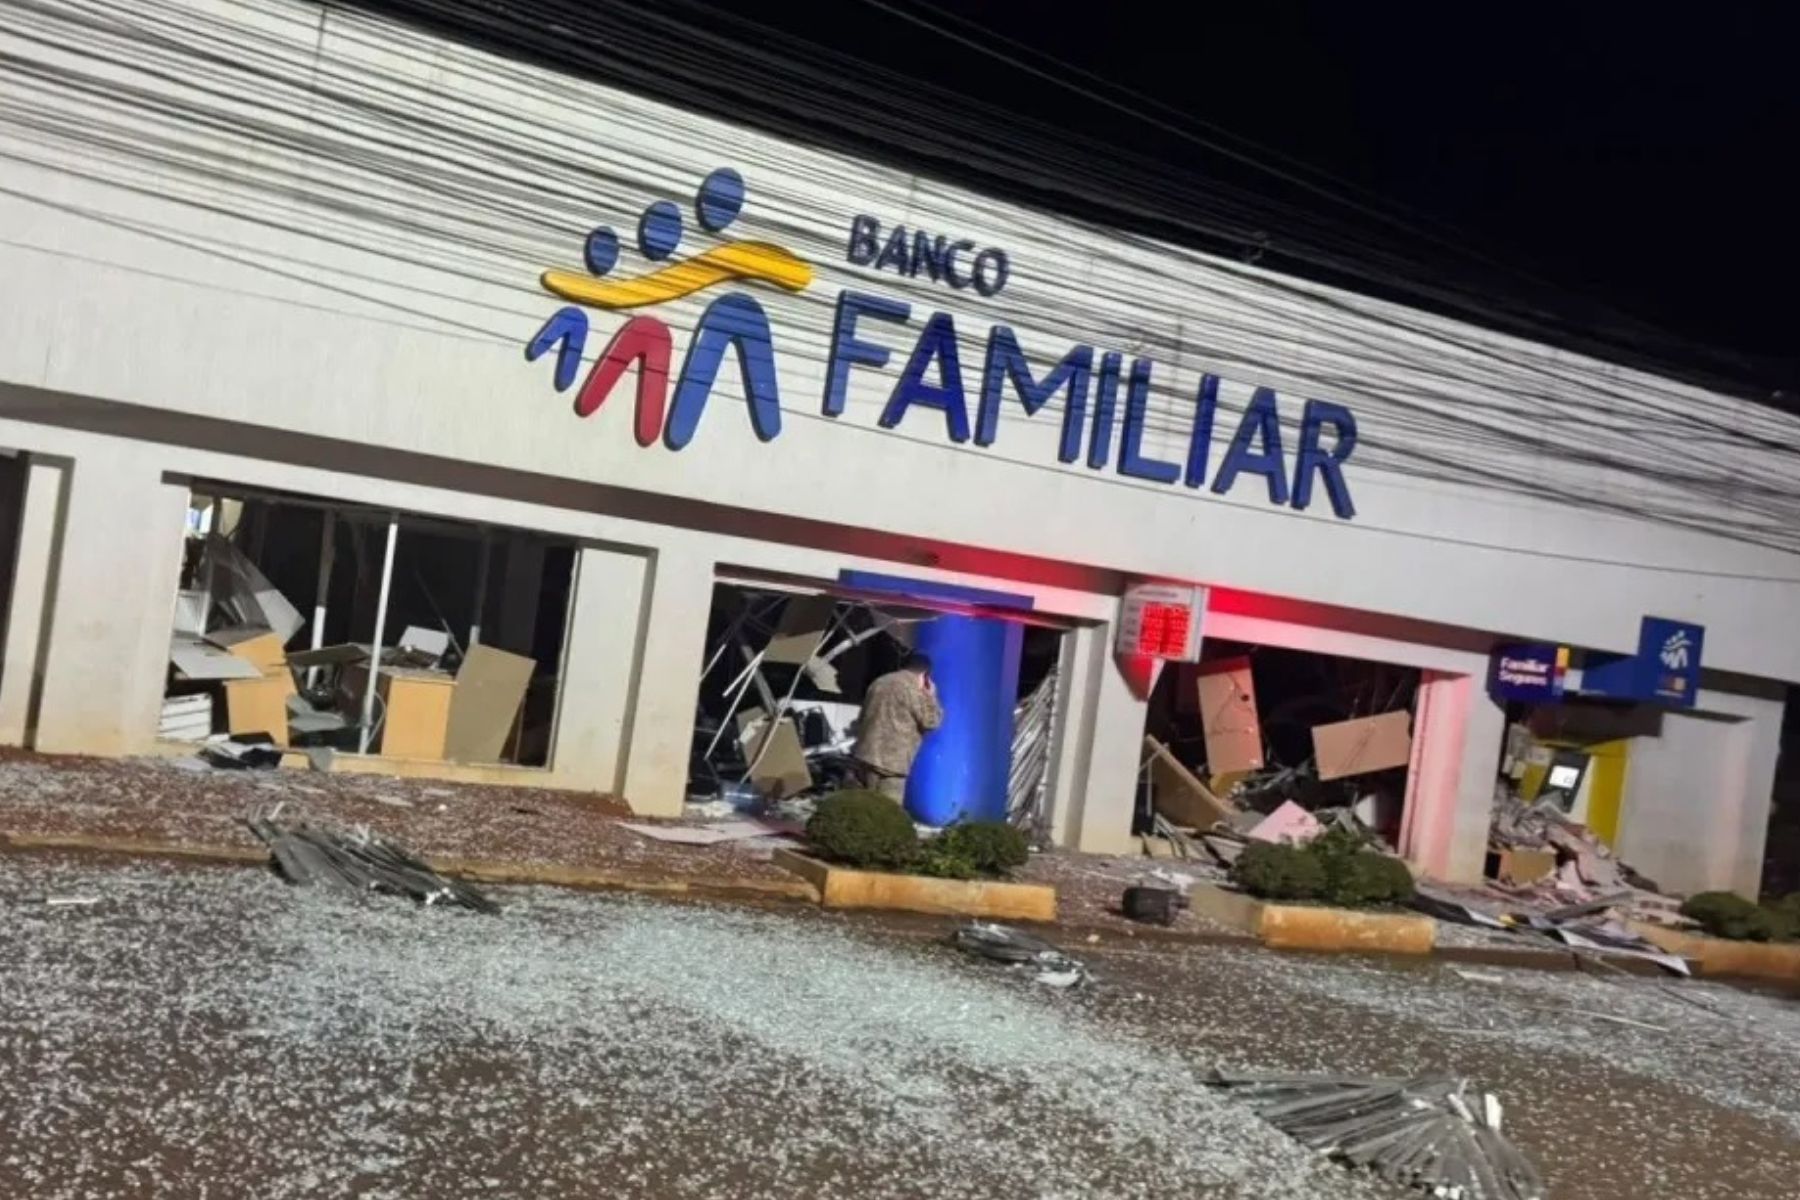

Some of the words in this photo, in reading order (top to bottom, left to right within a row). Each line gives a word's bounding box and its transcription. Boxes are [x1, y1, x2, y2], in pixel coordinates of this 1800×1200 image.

[847, 214, 1009, 297] BANCO
[821, 290, 1357, 519] FAMILIAR
[1500, 657, 1549, 673] Familiar
